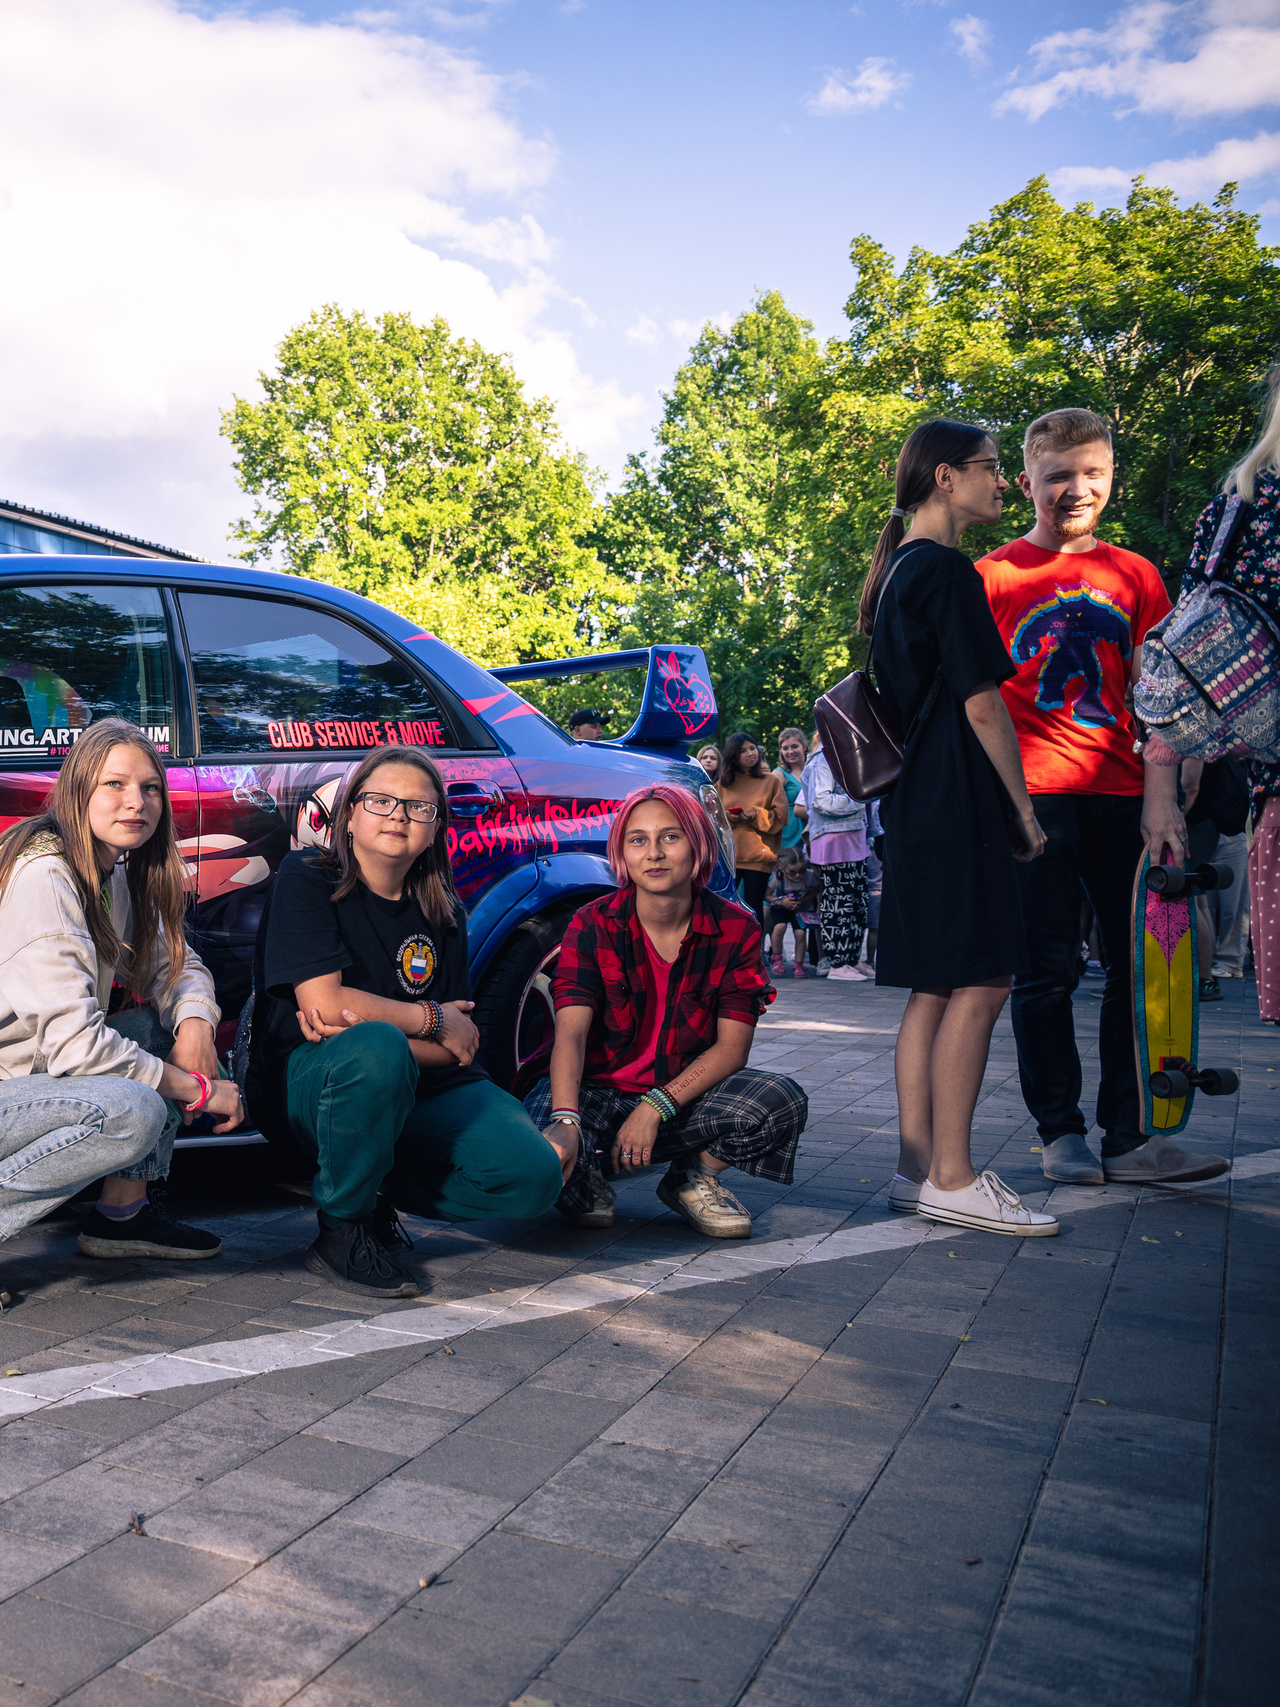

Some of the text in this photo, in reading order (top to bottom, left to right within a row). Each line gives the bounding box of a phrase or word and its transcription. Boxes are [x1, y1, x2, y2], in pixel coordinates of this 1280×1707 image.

[267, 720, 446, 748] CLUB SERVICE & MOVE
[672, 1064, 706, 1096] MEMENTO
